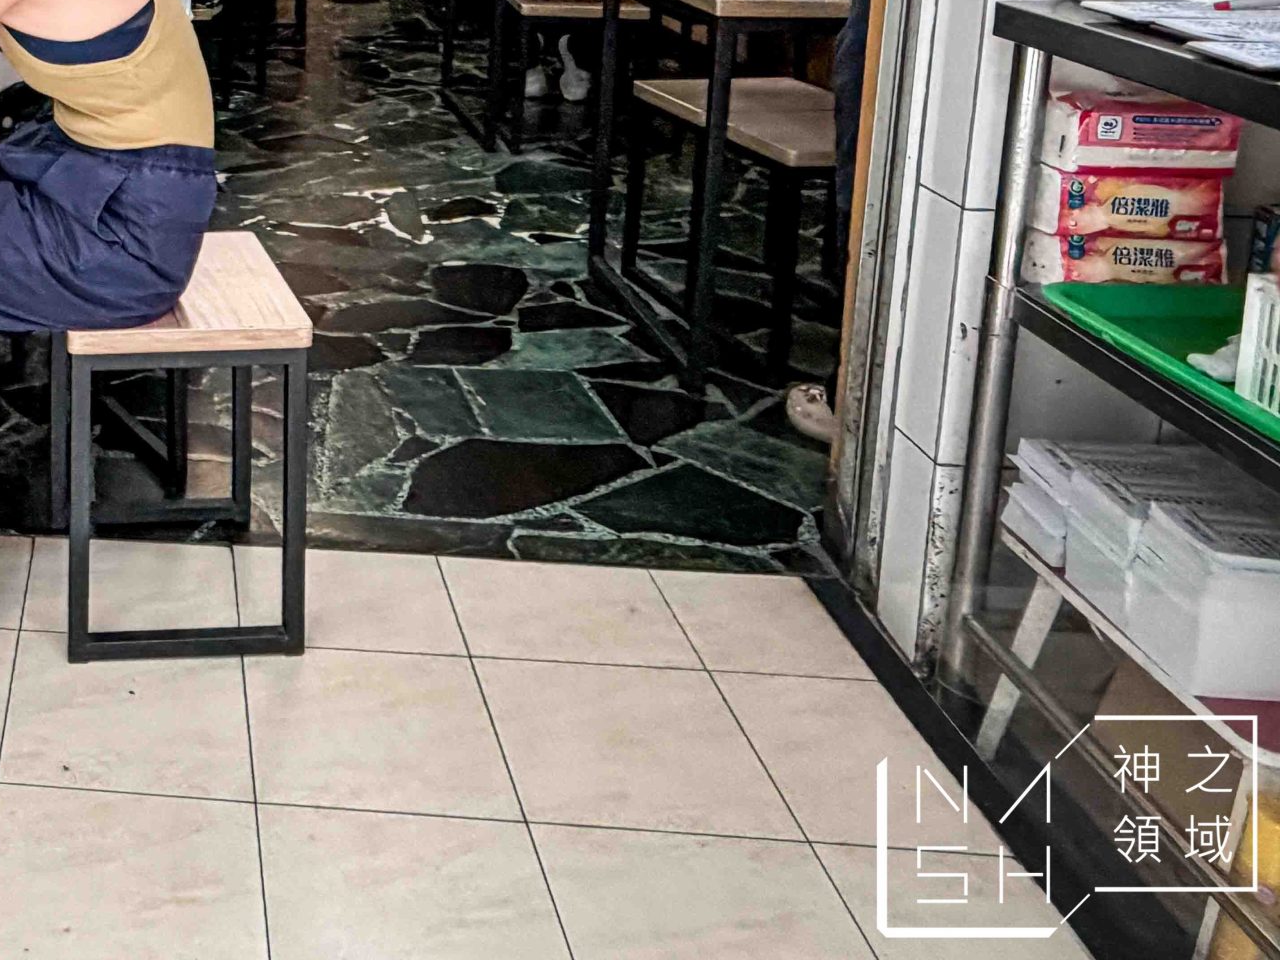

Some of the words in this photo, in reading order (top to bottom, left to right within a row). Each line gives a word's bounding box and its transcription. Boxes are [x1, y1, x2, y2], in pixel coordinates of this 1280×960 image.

[1111, 196, 1171, 218] 倍潔雅
[1112, 246, 1175, 269] 倍潔雅
